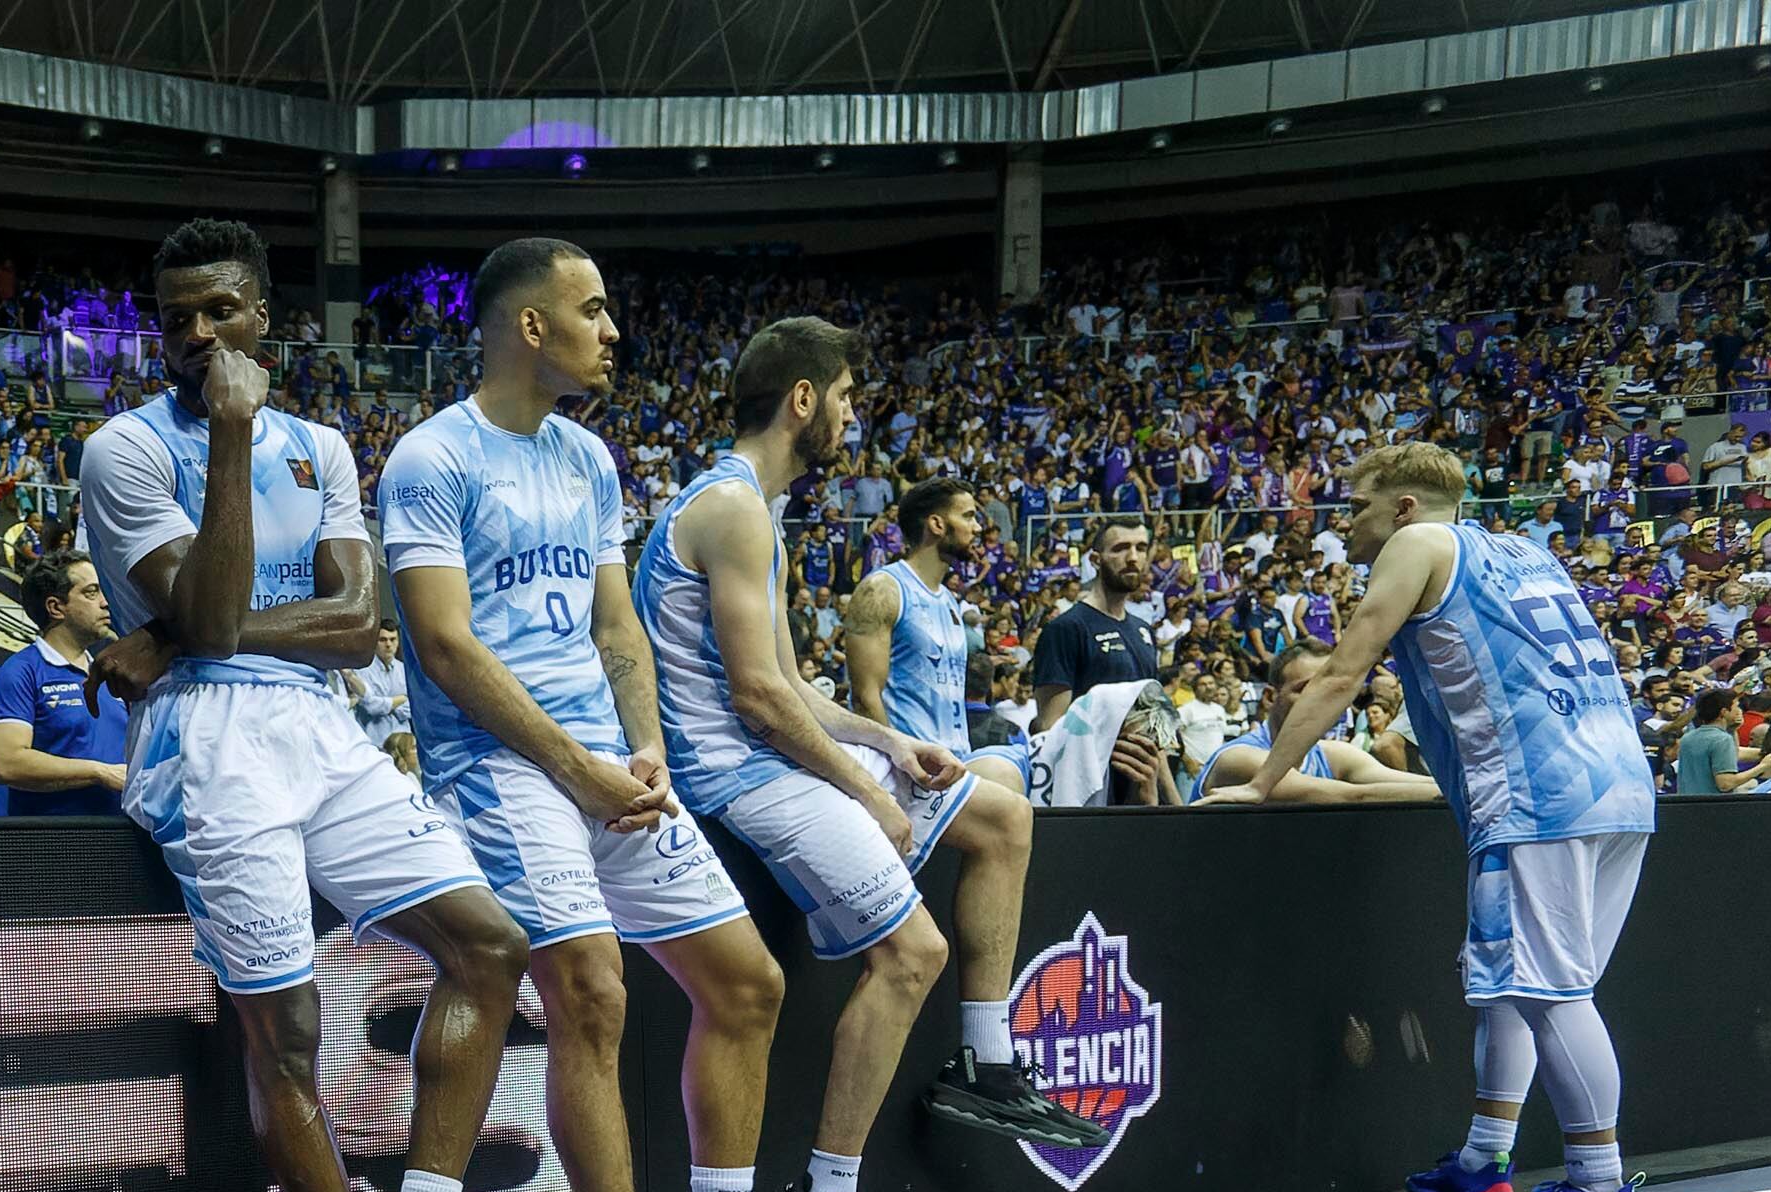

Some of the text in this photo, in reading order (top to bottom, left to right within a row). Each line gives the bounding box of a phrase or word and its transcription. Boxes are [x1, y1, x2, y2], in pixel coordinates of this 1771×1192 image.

[545, 591, 575, 637] 0
[1510, 593, 1616, 678] 55
[246, 946, 301, 968] GIVOVA
